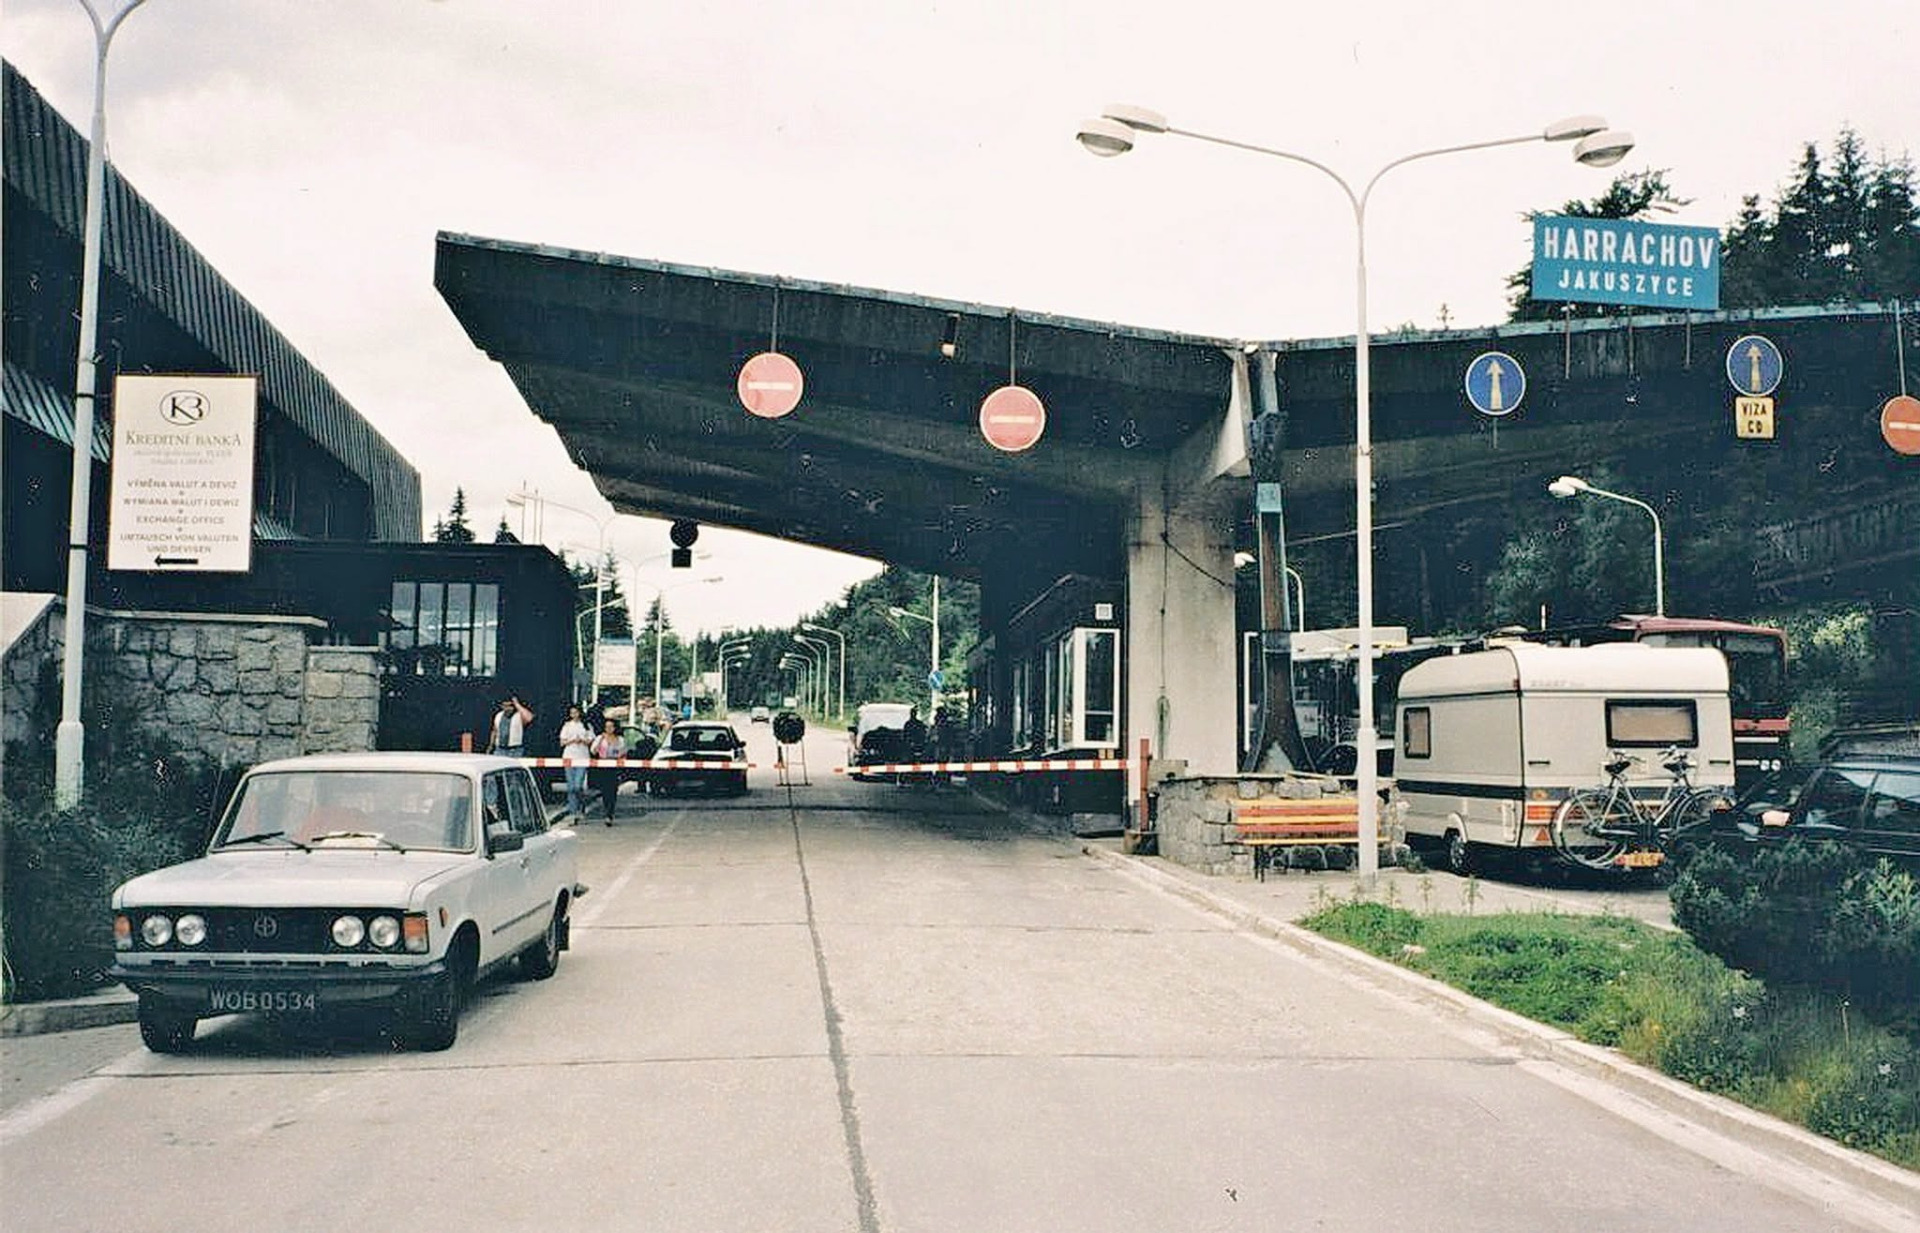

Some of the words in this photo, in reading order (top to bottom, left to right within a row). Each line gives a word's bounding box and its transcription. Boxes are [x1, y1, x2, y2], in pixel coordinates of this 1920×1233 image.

[1544, 226, 1714, 269] HARRACHOV
[1558, 269, 1694, 297] JAKUSZYCE
[1741, 402, 1767, 416] VIZA
[170, 480, 198, 489] VALUT
[210, 480, 238, 489] DEVIZ
[123, 498, 169, 506] WYMIANA
[171, 498, 202, 507] WALUT
[209, 499, 239, 507] DEWIZ
[136, 516, 190, 524] EXCHANGE
[191, 516, 225, 525] OFFICE
[120, 533, 173, 542] UMTAUSCH
[174, 534, 195, 542] VON
[197, 534, 239, 542] VALUTEN
[146, 545, 169, 553] UND
